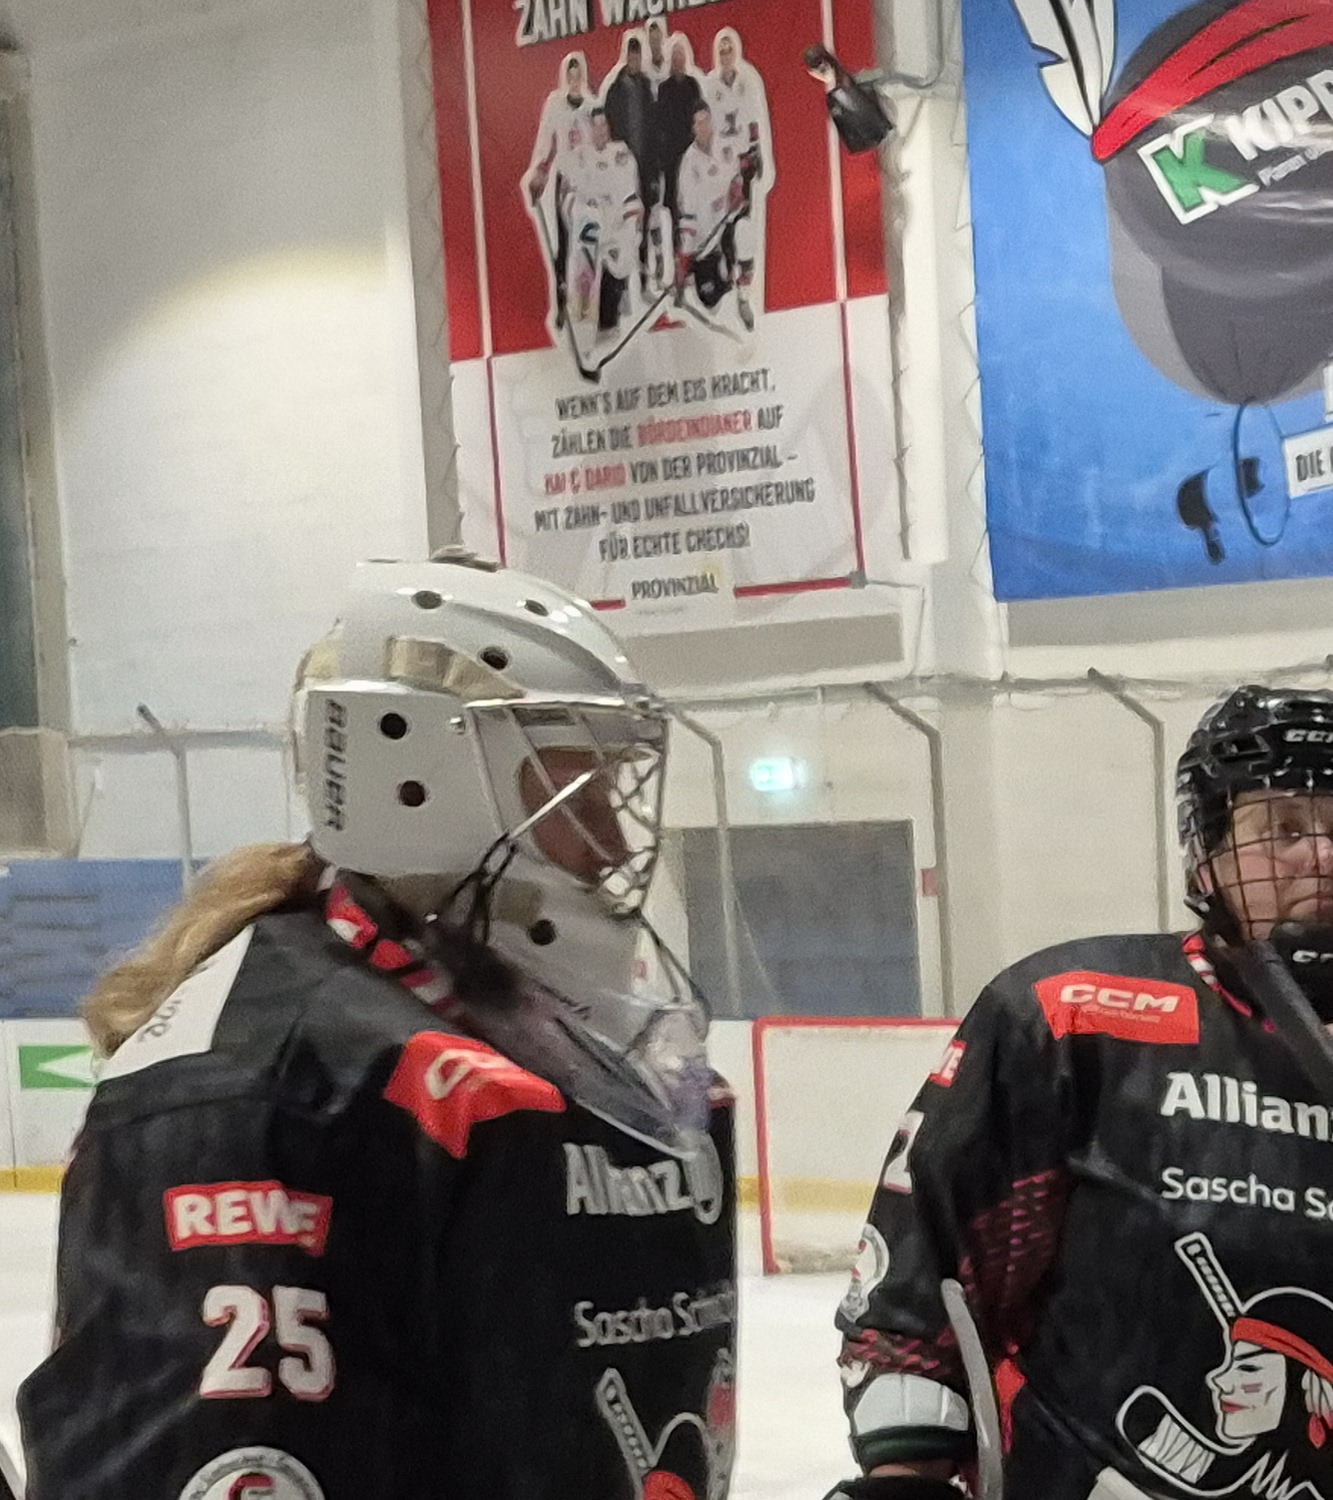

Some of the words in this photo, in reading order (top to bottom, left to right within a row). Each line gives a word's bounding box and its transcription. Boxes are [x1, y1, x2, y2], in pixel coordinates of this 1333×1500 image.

[614, 387, 641, 415] AUF
[647, 380, 679, 410] DEM
[682, 378, 707, 405] EIS
[609, 425, 634, 451] DIE
[757, 404, 784, 430] AUF
[629, 460, 659, 484] VON
[662, 455, 693, 482] DER
[696, 445, 784, 476] PROVINZIAL
[1296, 449, 1326, 483] DIE
[534, 507, 559, 532] MIT
[565, 503, 608, 531] ZAHN-
[610, 498, 641, 524] UND
[643, 477, 817, 522] UNFALLVERSICHERUNG
[599, 529, 629, 562] FÜR
[632, 530, 682, 559] ECHTE
[630, 571, 720, 600] PROVINZIAL
[323, 698, 348, 832] BAUER
[1060, 983, 1181, 1013] CCM
[1160, 1165, 1296, 1213] Sascha
[173, 1189, 320, 1247] REWE
[200, 1283, 338, 1402] 25
